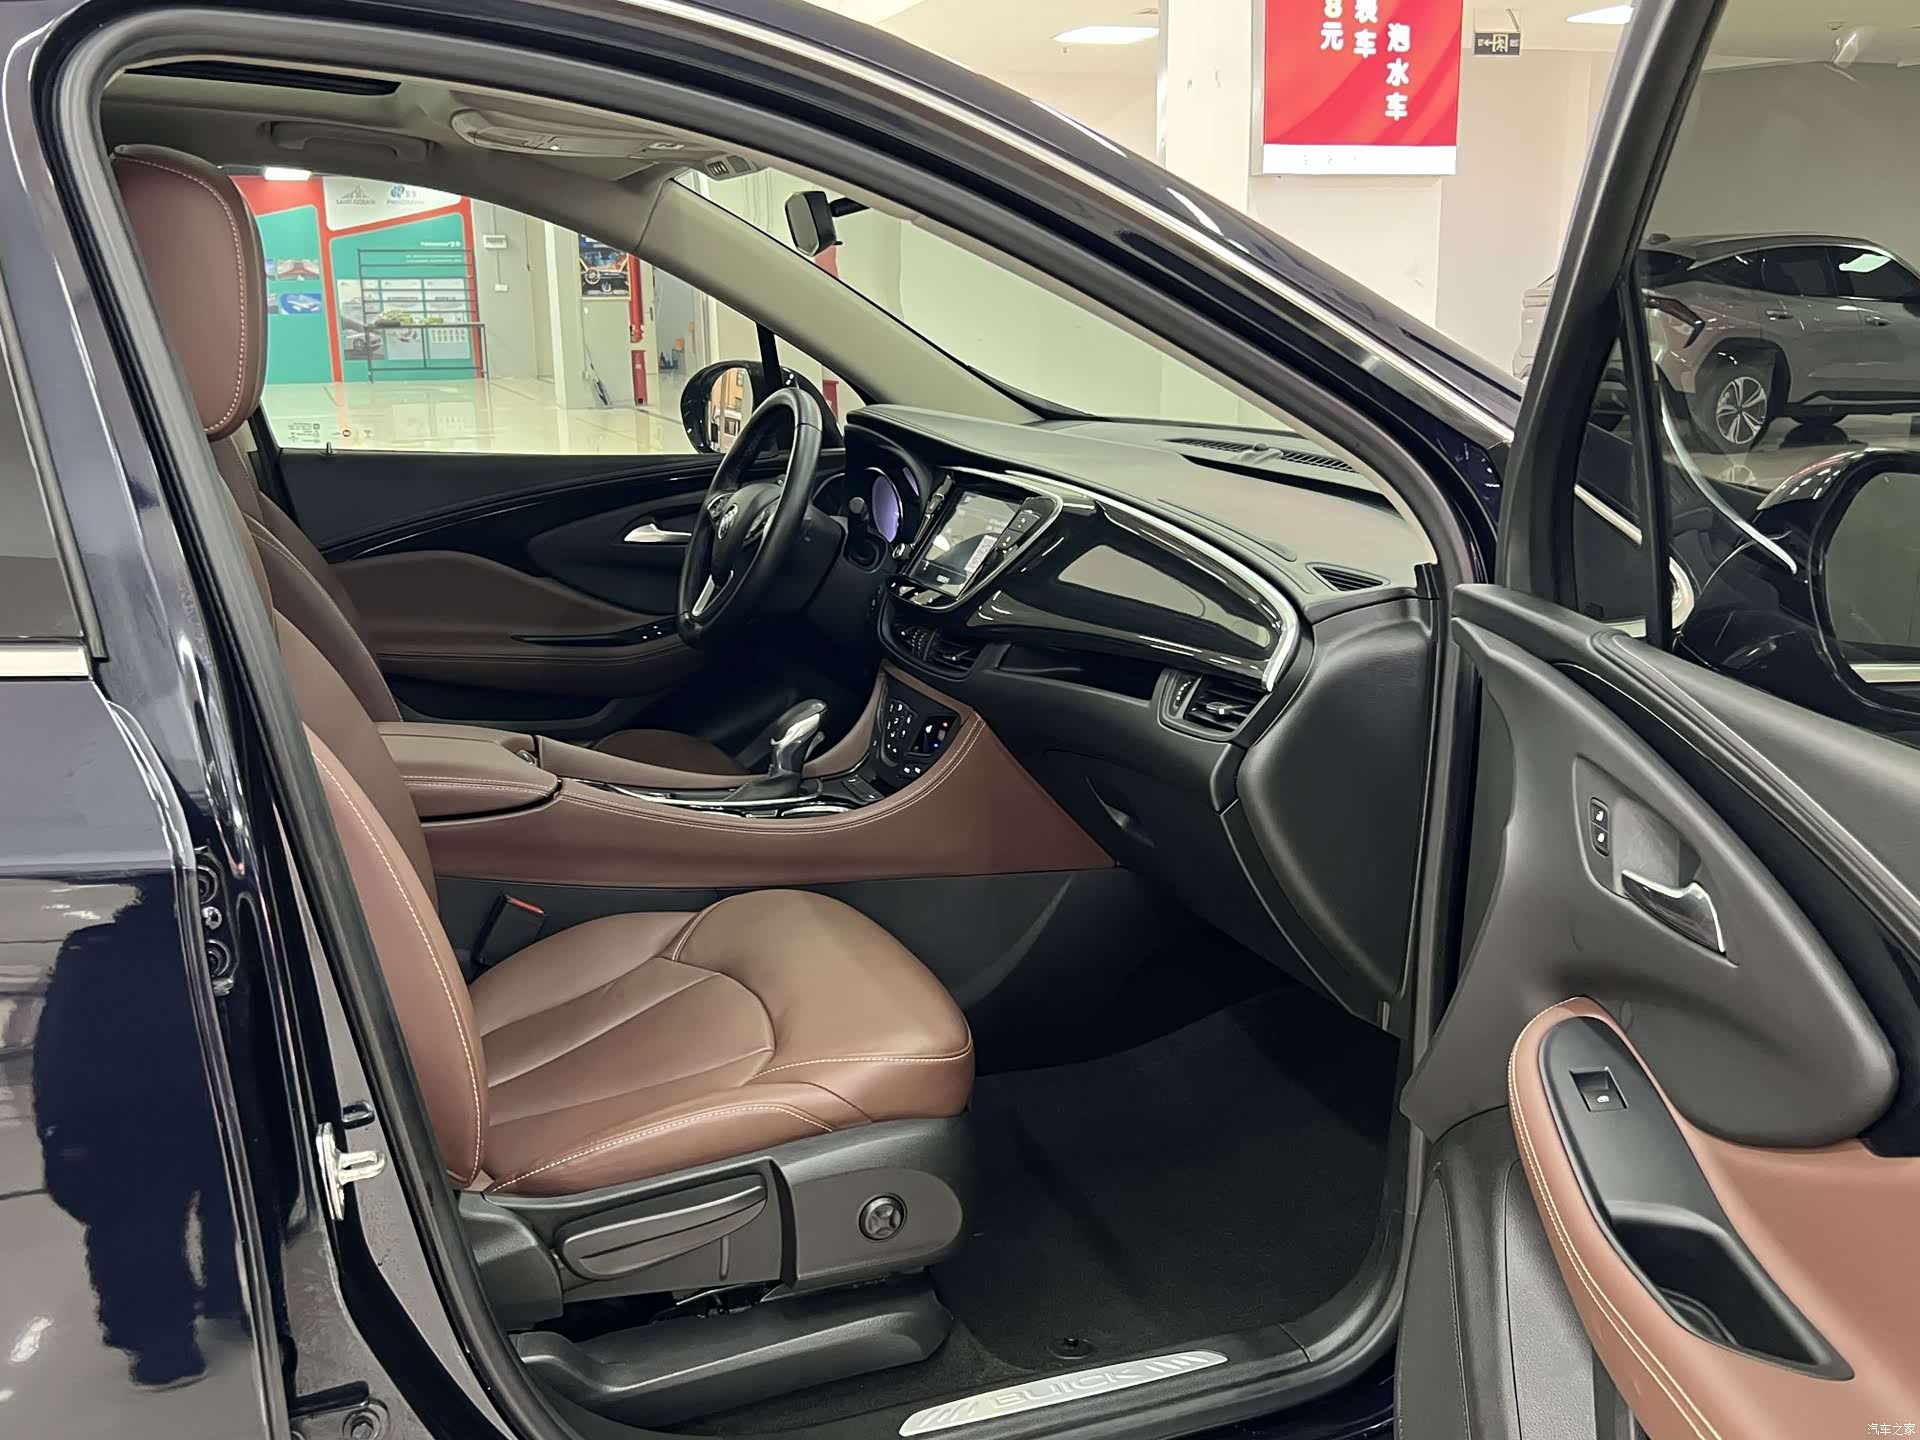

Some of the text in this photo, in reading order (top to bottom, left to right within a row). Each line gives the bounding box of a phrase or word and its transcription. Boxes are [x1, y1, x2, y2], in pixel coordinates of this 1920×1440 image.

[1384, 22, 1411, 121] 泡水车
[994, 1371, 1141, 1407] BUICK
